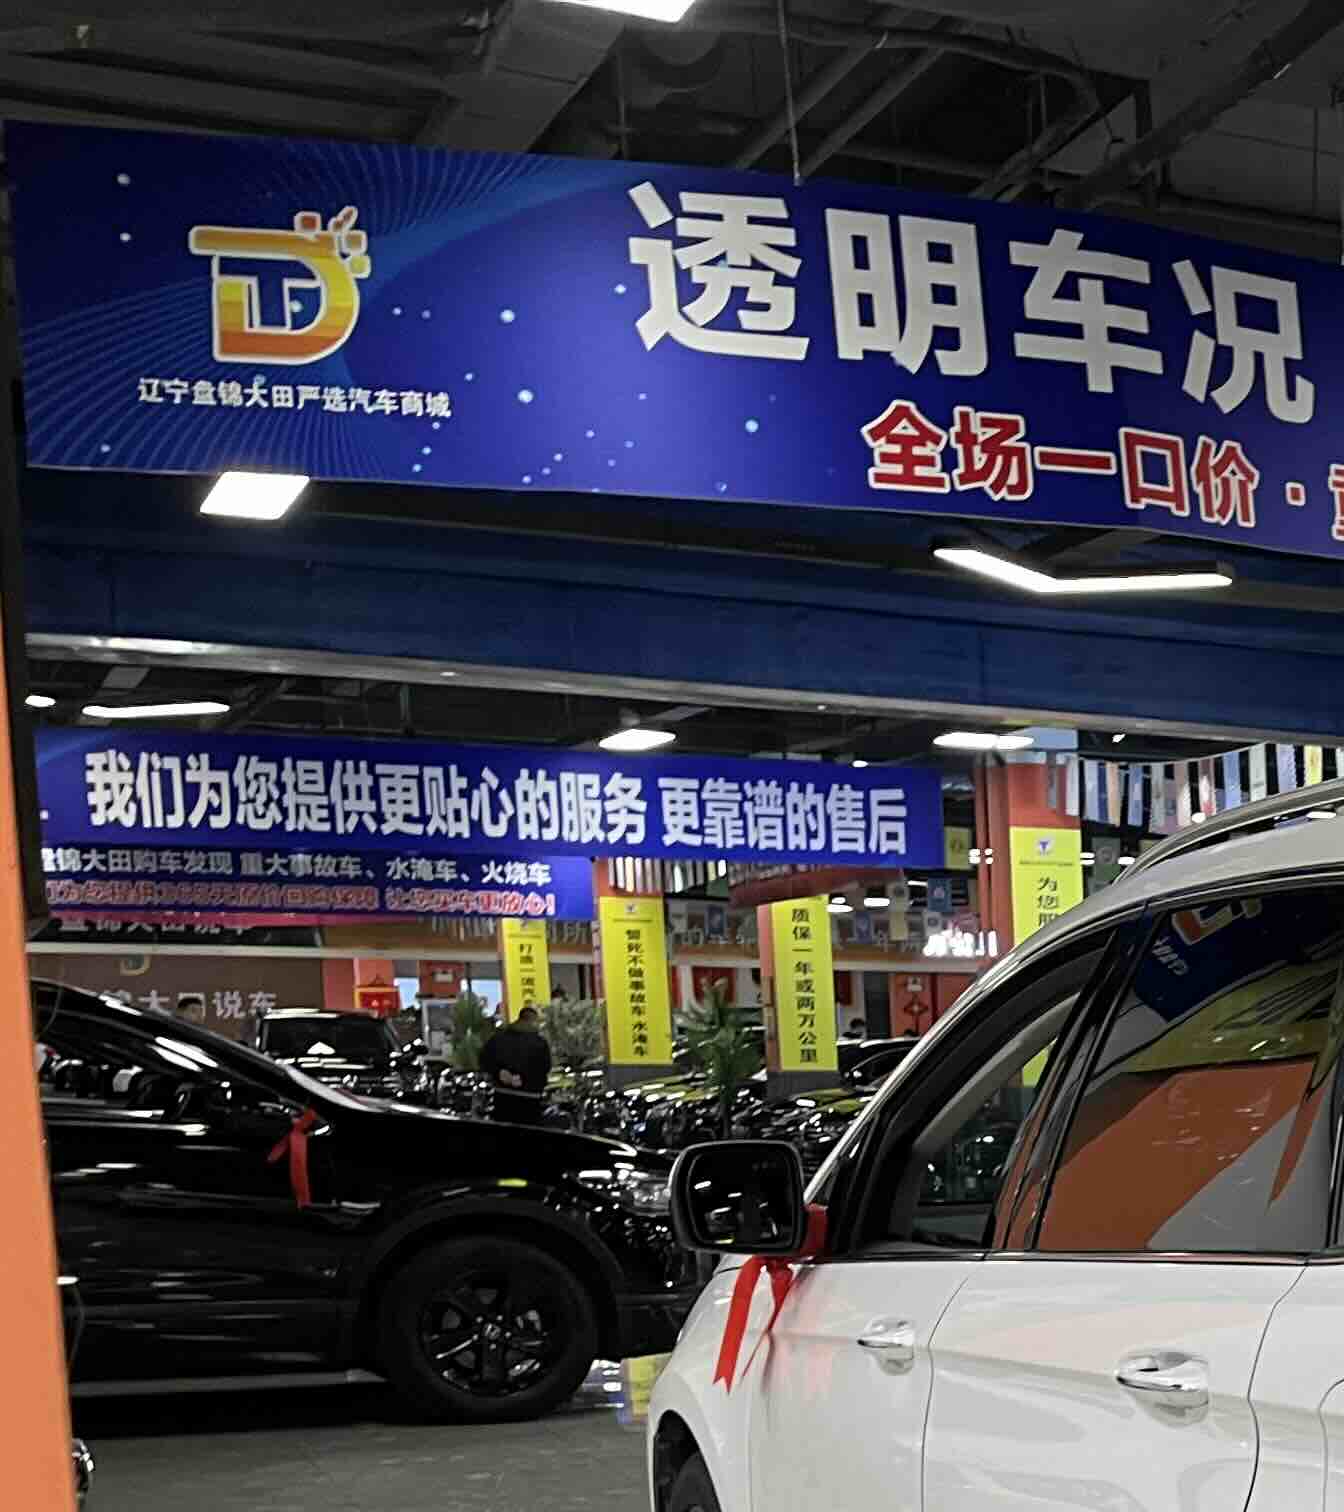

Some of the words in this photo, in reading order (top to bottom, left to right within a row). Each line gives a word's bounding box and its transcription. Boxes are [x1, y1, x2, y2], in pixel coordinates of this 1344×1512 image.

[628, 181, 1315, 425] 透明车况
[138, 377, 451, 417] 辽宁盘锦大田严选汽车商城
[85, 750, 647, 845] 我们为您提供更贴心的服务
[658, 776, 906, 855] 更靠谱的售后
[791, 907, 818, 1063] 质保一年或两万公里
